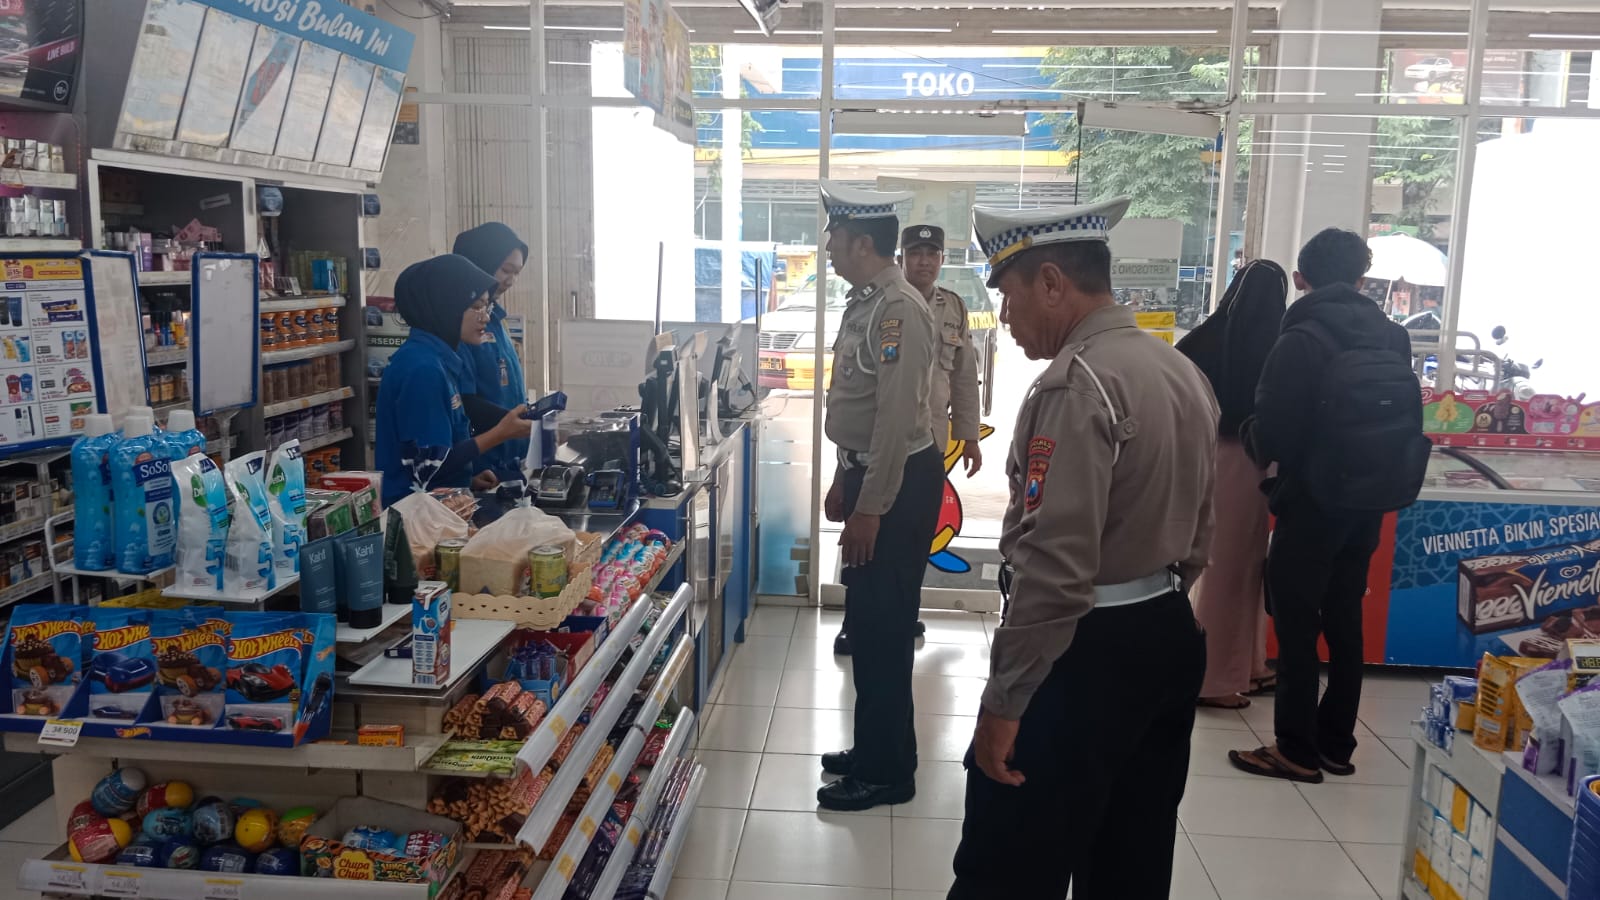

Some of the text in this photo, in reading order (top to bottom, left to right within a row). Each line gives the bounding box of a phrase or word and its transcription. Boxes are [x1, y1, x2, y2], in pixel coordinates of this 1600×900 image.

[298, 1, 366, 44] Bulan
[364, 27, 393, 57] Ini
[902, 71, 976, 97] TOKO
[1422, 527, 1500, 555] VIENNETTA
[1503, 520, 1544, 543] BIKIN
[308, 548, 327, 565] Kahf
[355, 543, 375, 558] Kahf
[339, 858, 370, 871] Chupa
[338, 868, 370, 880] Chups
